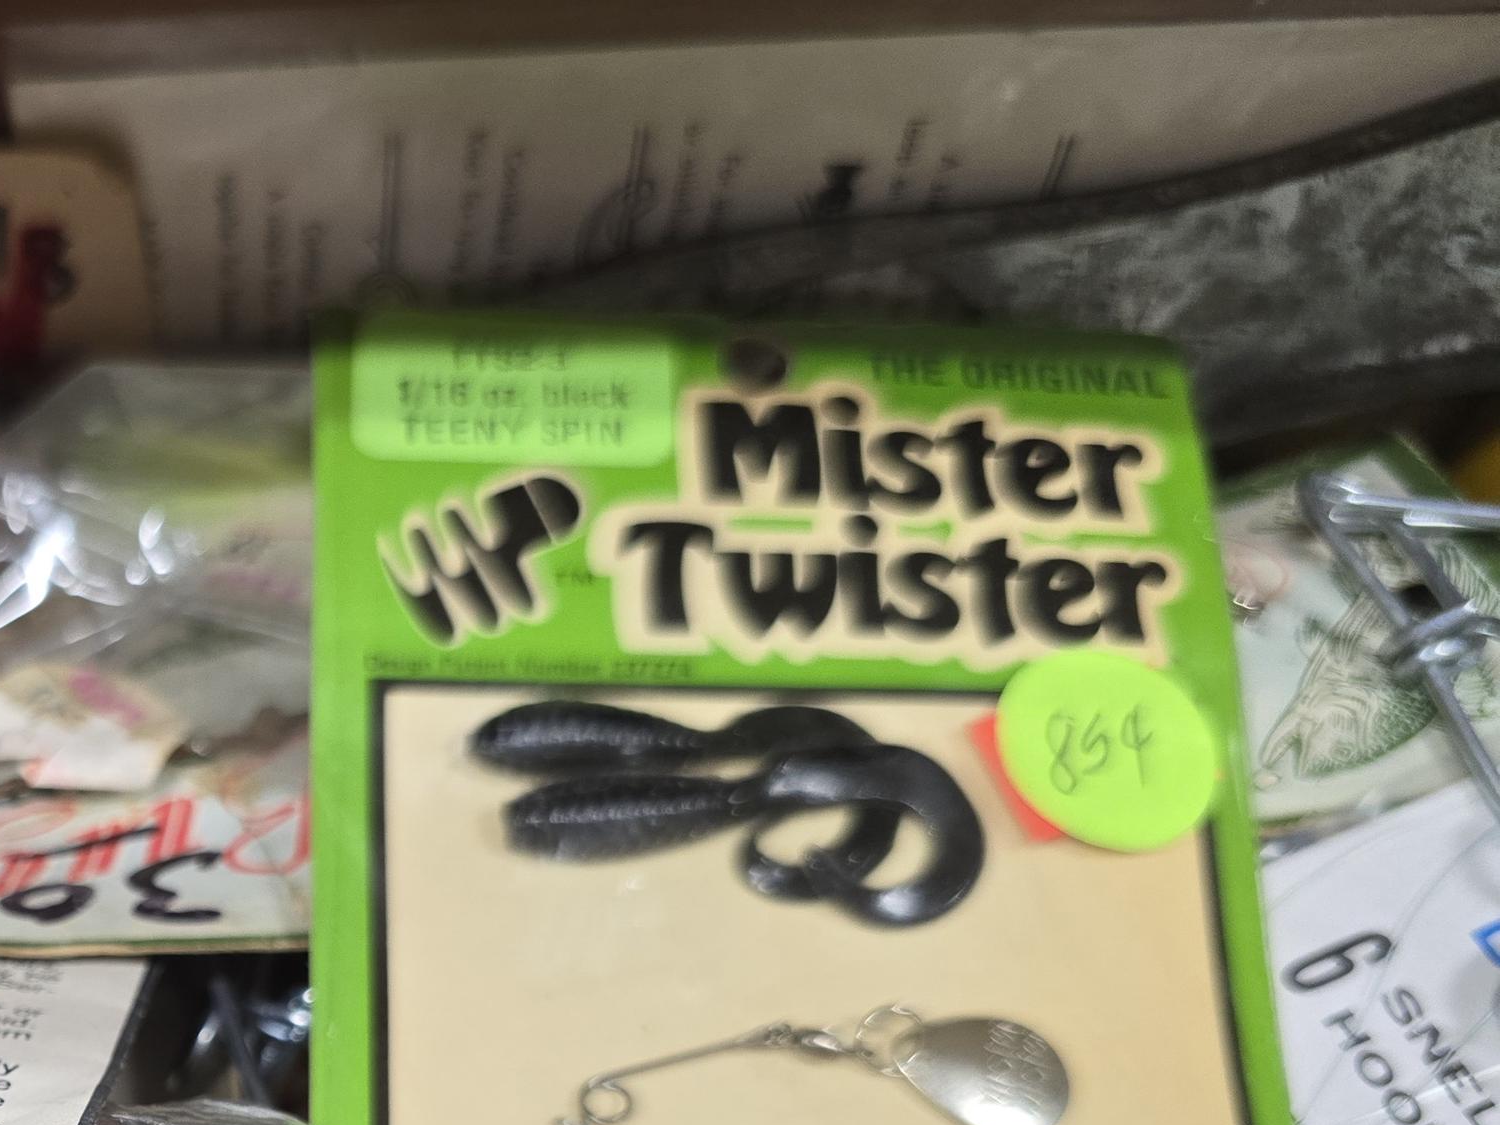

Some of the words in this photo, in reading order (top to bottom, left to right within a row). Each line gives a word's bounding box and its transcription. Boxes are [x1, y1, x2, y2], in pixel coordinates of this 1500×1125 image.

[868, 355, 950, 388] THE
[959, 361, 1170, 400] ORIGINAL
[399, 416, 528, 446] TEENY
[541, 417, 624, 447] SPIN
[701, 397, 1143, 522] Mister
[623, 514, 1167, 647] Twister
[1280, 930, 1393, 992] 6
